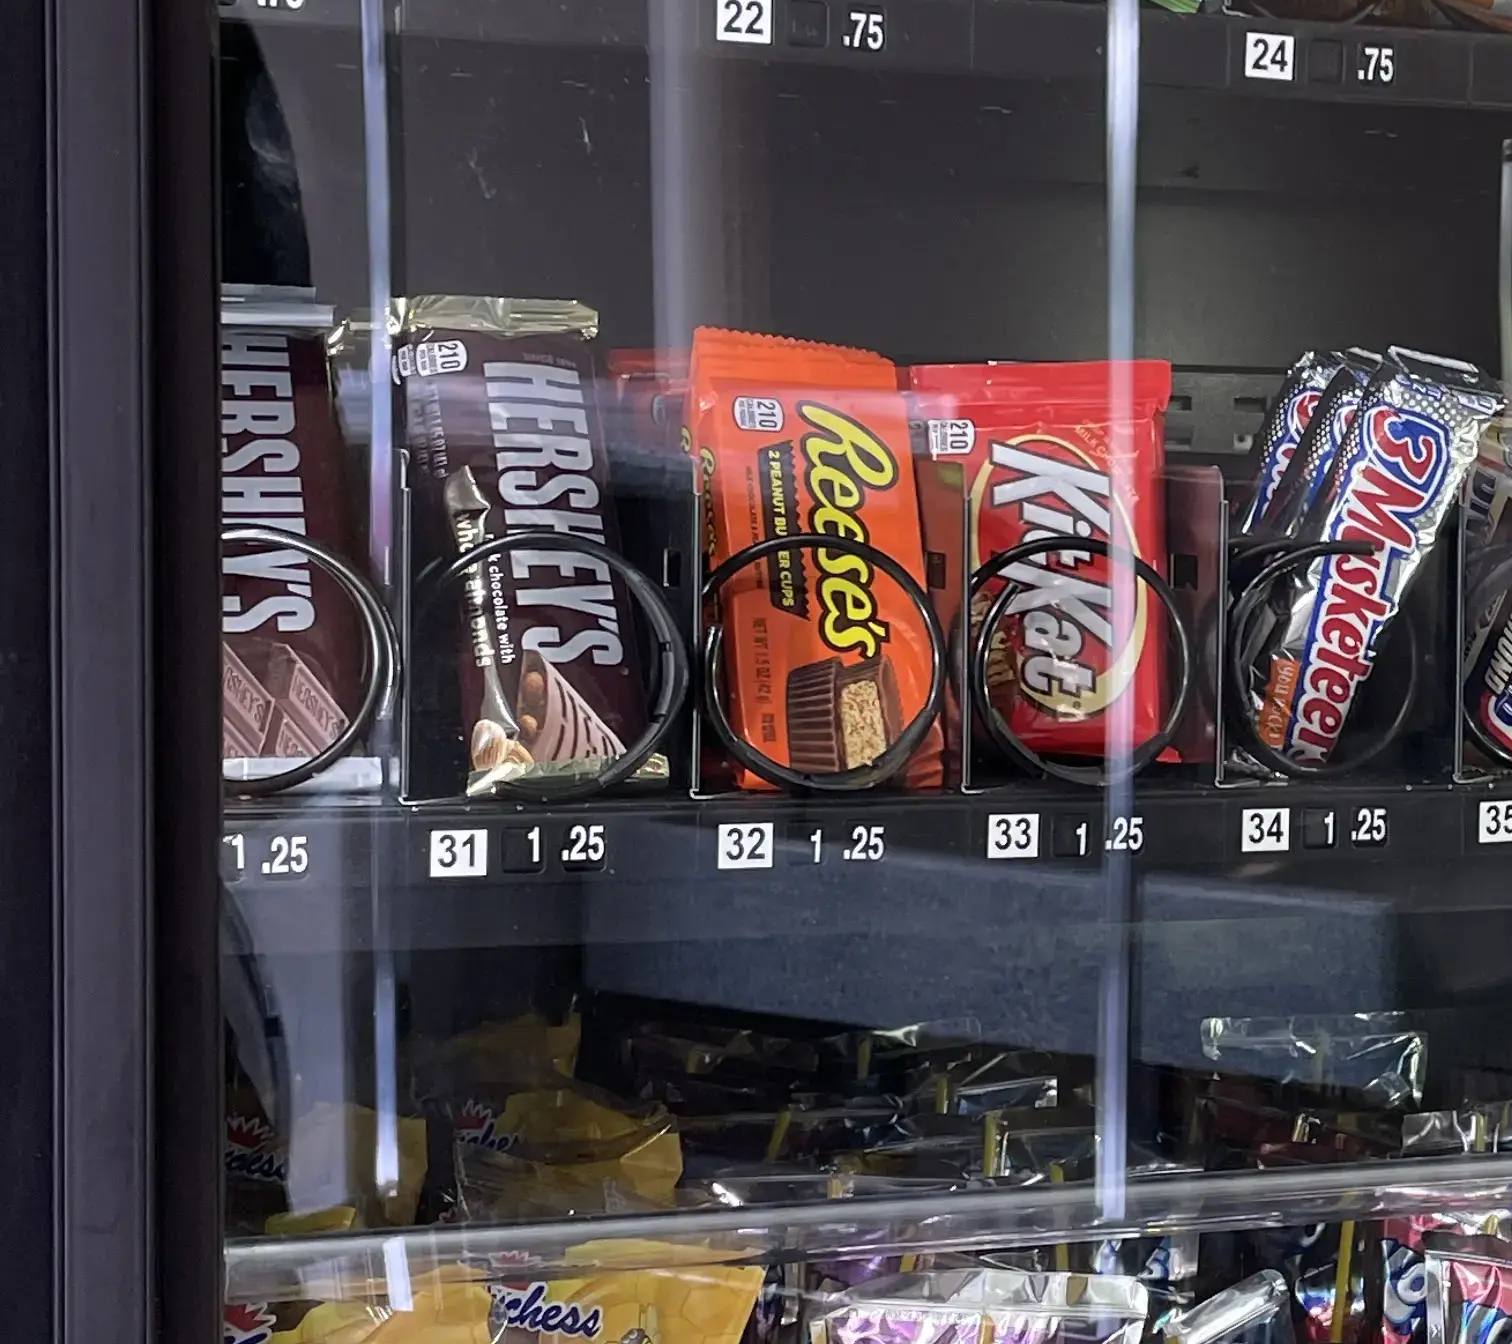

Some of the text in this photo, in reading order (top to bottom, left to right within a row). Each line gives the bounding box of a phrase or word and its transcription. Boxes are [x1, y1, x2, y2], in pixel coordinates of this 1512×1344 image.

[724, 0, 765, 36] 22
[843, 12, 884, 49] .75
[1252, 39, 1288, 71] 24
[1358, 48, 1393, 82] .75
[438, 343, 460, 369] 210
[755, 403, 775, 428] 210
[949, 422, 967, 451] 210
[1368, 408, 1445, 489] 3
[482, 362, 624, 667] HERSHEY'S
[992, 444, 1110, 566] Kit
[771, 462, 794, 606] PEANUT BUER CUPS
[800, 404, 894, 657] Reese's
[489, 566, 515, 664] chocolate with
[1000, 563, 1115, 709] Kat
[726, 830, 766, 861] 32
[995, 820, 1032, 849] 33
[1249, 815, 1283, 843] 34
[436, 834, 480, 869] 31
